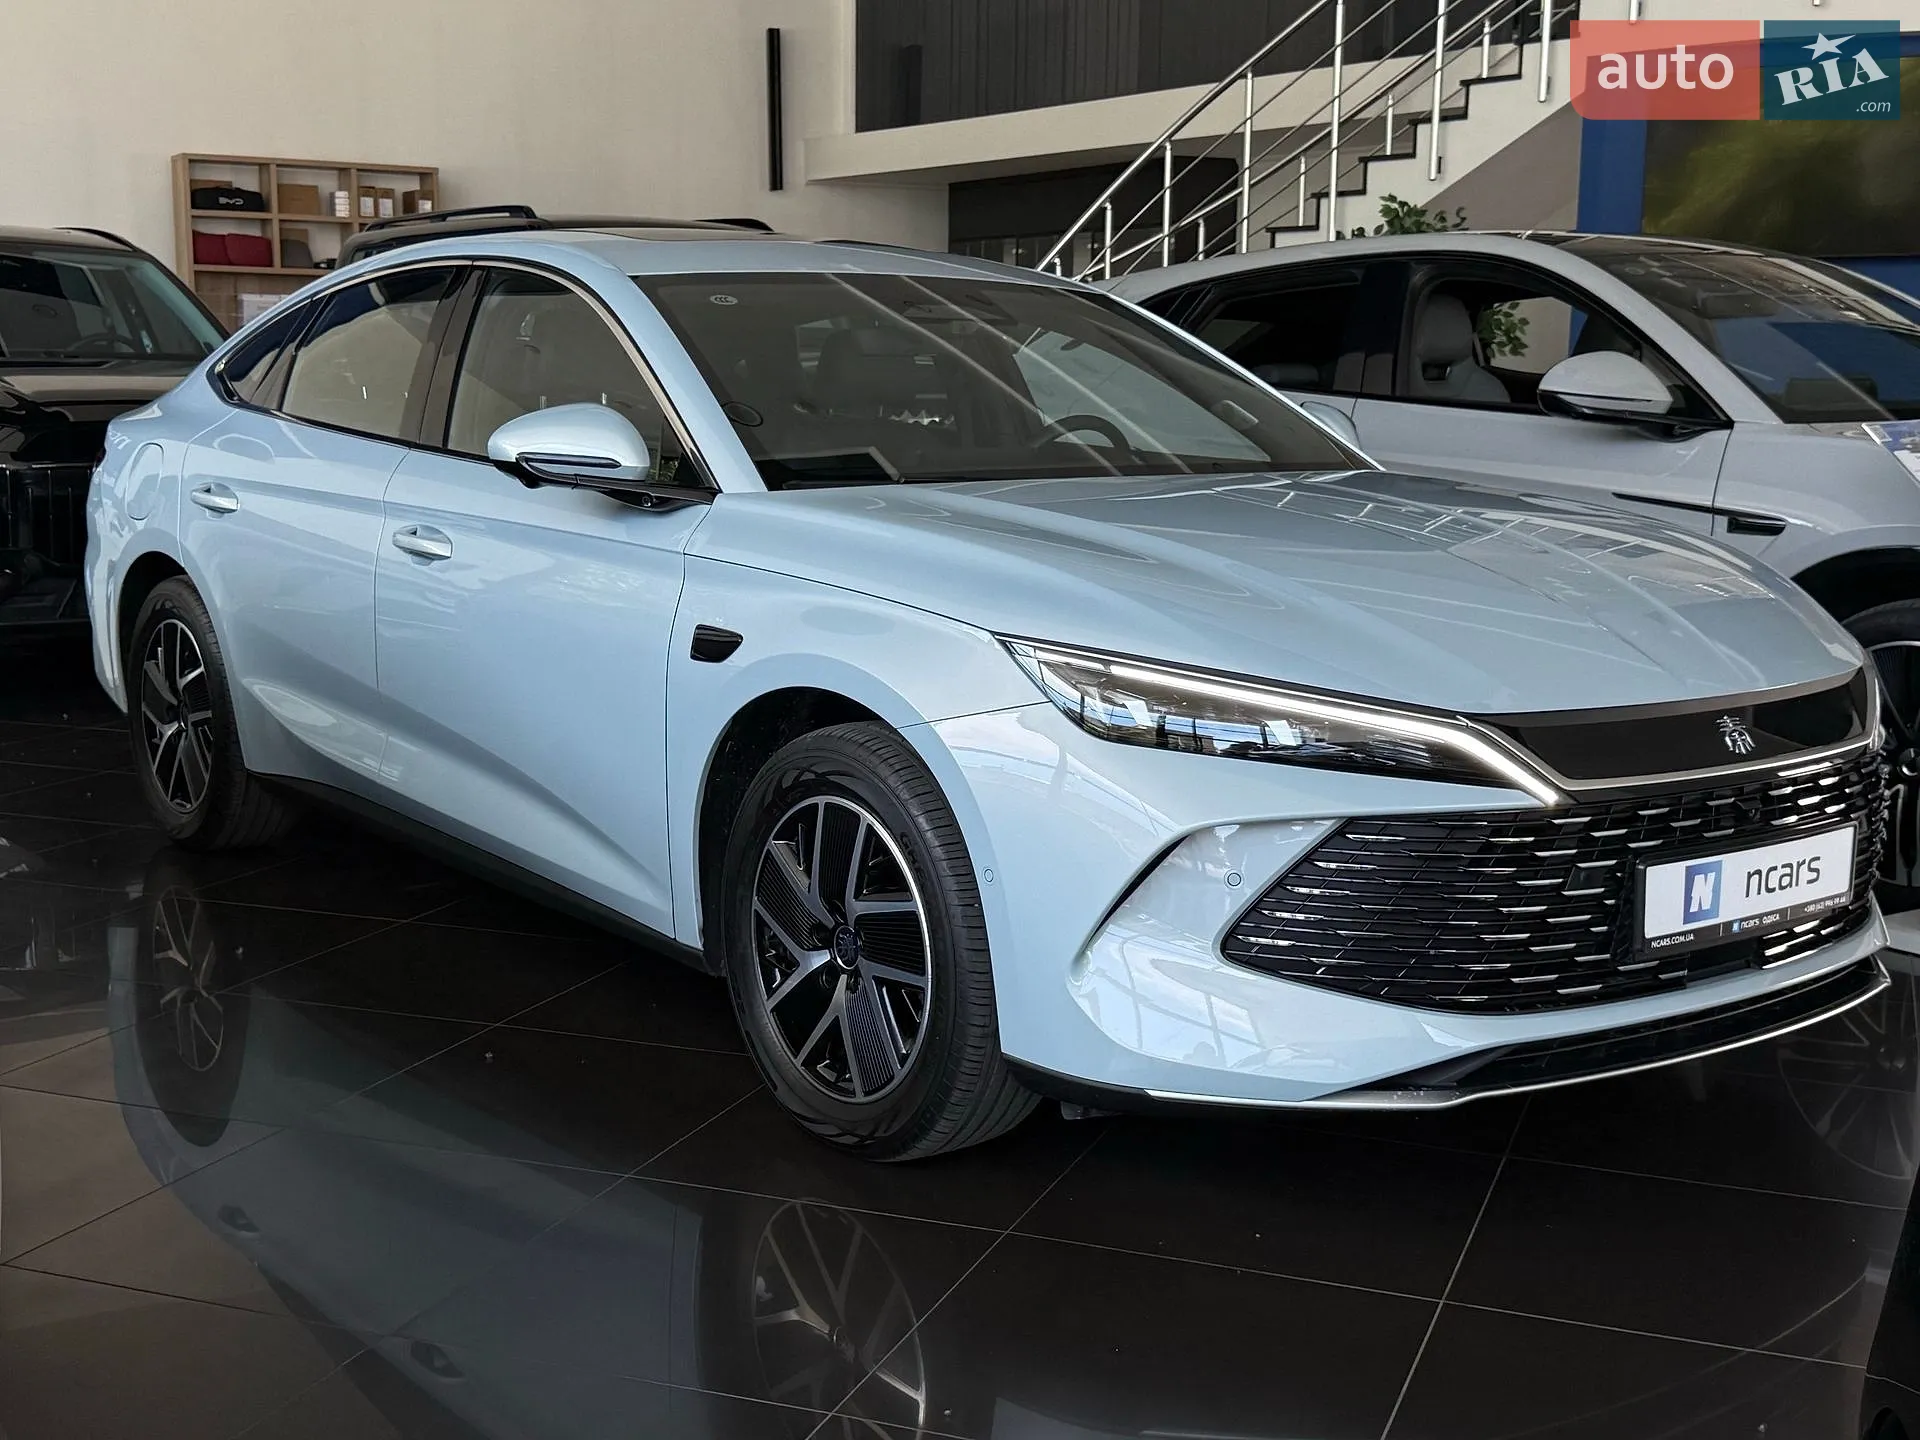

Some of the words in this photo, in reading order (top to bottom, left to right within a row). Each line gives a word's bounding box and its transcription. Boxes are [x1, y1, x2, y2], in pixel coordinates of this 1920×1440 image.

[1745, 856, 1821, 898] ncars
[1740, 918, 1760, 929] ncars
[1650, 933, 1694, 948] NCARS.COM.UA
